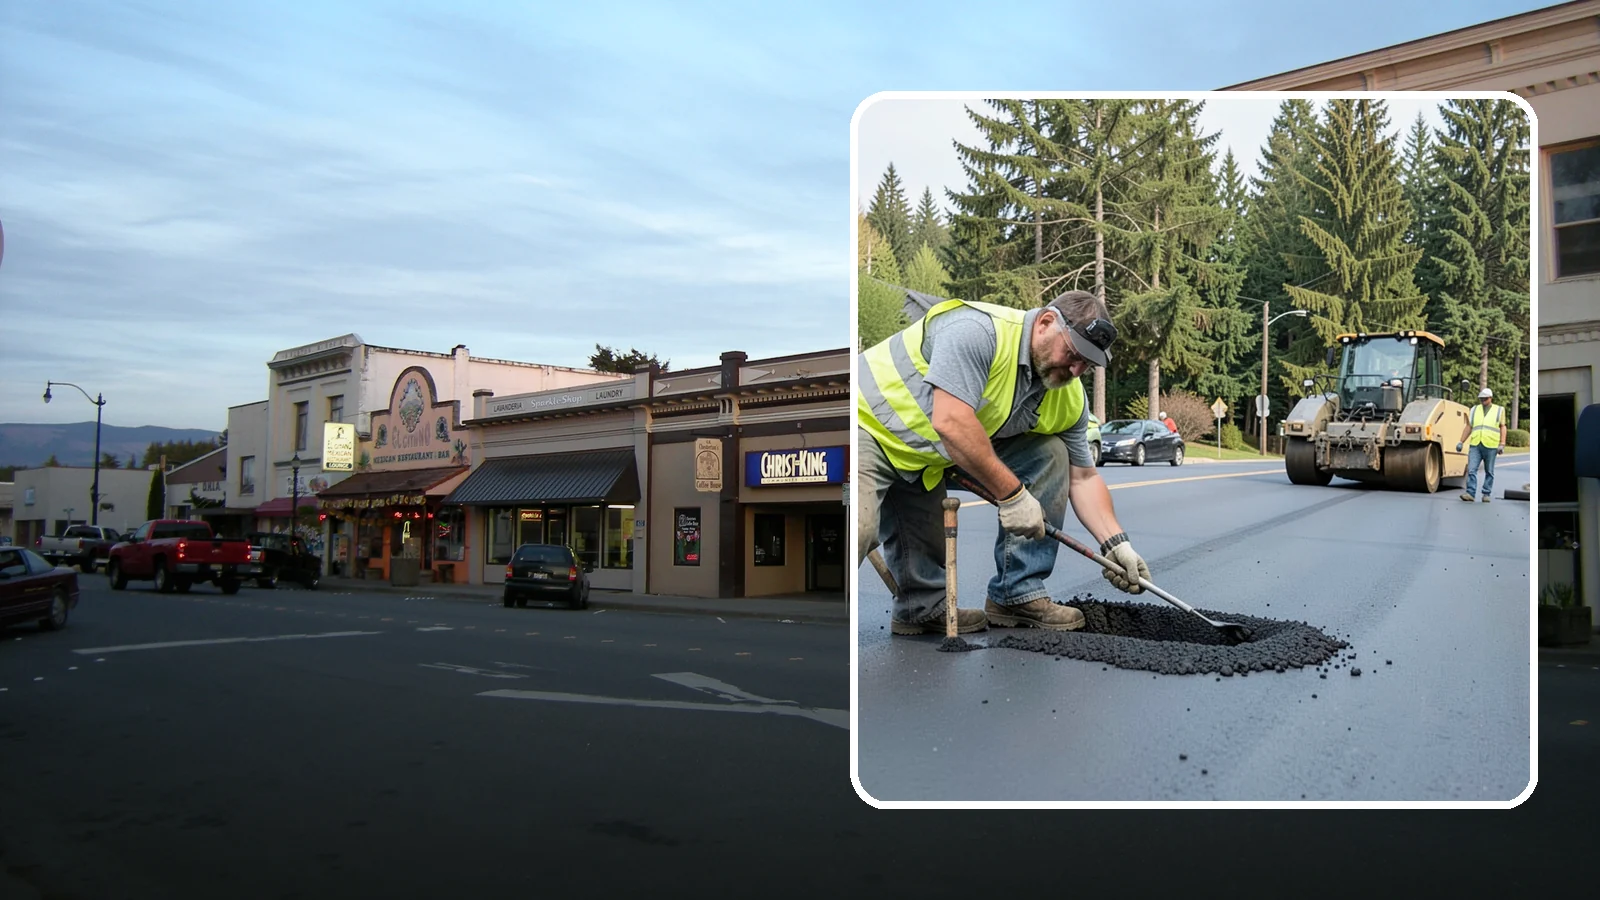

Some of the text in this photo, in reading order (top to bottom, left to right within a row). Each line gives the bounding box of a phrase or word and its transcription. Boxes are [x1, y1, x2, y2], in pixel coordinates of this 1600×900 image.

[493, 389, 623, 412] LAVANDERIA Sparkle Shop LAUNDRY
[374, 455, 396, 463] MEXICAN
[397, 451, 434, 462] RESTAURANT
[438, 450, 450, 459] BAR
[761, 450, 828, 477] CHRIST KING
